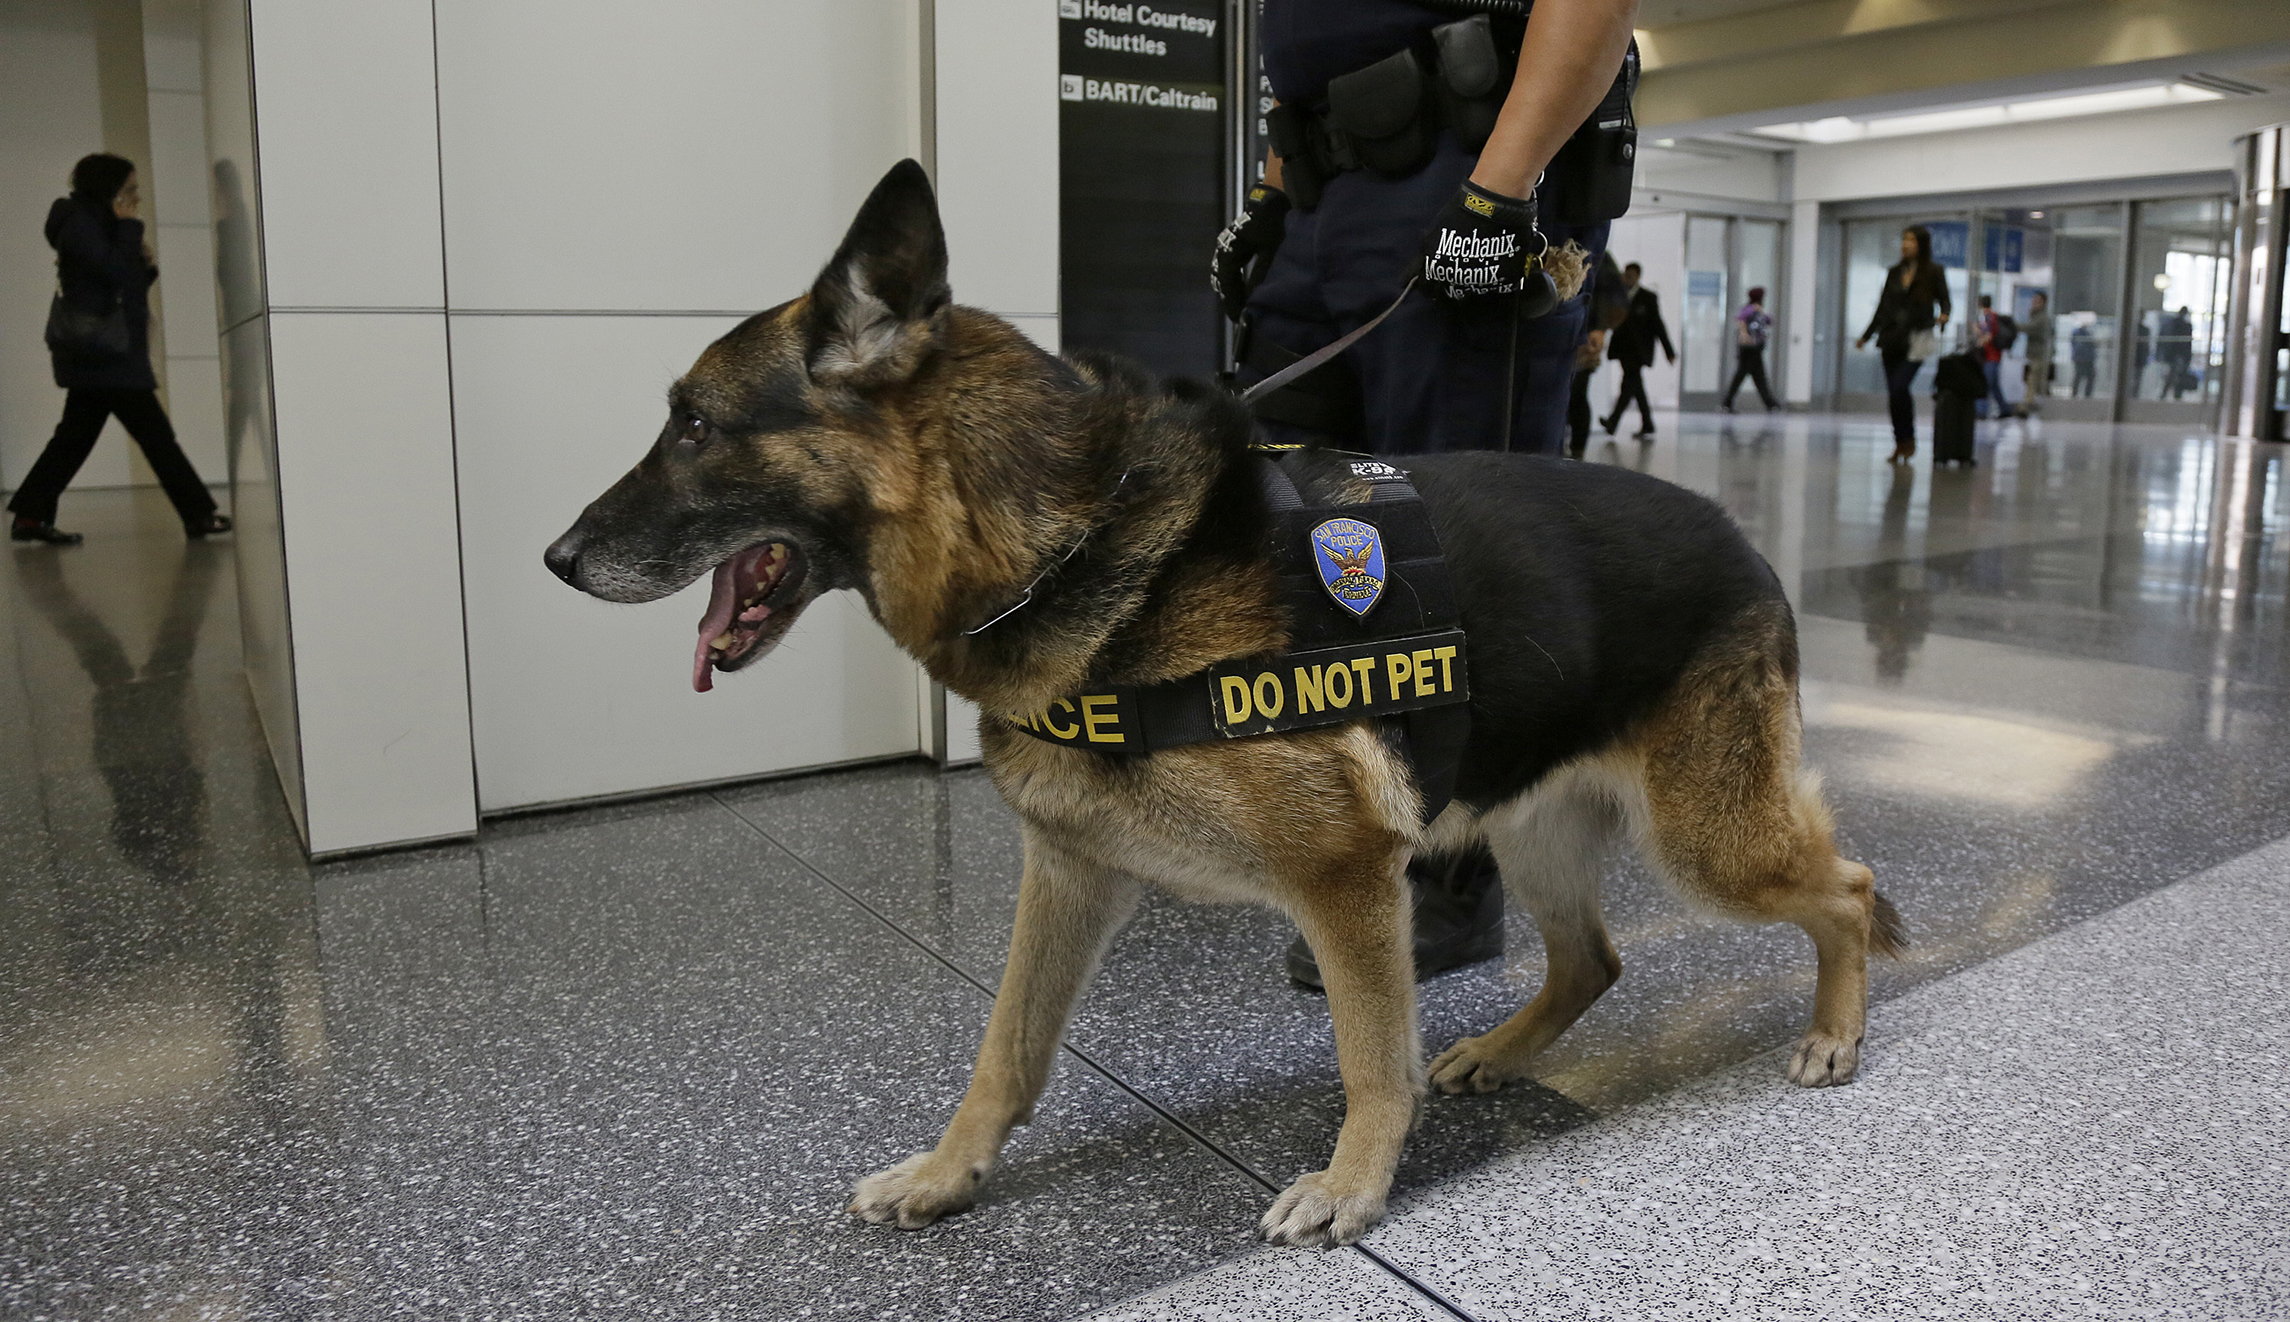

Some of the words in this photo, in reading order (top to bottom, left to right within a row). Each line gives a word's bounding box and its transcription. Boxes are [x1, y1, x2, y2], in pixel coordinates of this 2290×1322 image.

[1084, 0, 1133, 23] Hotel
[1137, 5, 1217, 38] Courtesy
[1084, 27, 1167, 56] Shuttles
[1085, 79, 1218, 112] BART/Caltrain
[1436, 227, 1516, 258] Mechanix
[1425, 255, 1500, 286] Mechanix
[1315, 525, 1333, 542] SAN
[1330, 521, 1375, 540] FRANCISCO
[1330, 535, 1363, 547] POLICE
[1220, 671, 1284, 726] DO
[1294, 656, 1376, 715] NOT
[1386, 645, 1457, 701] PET
